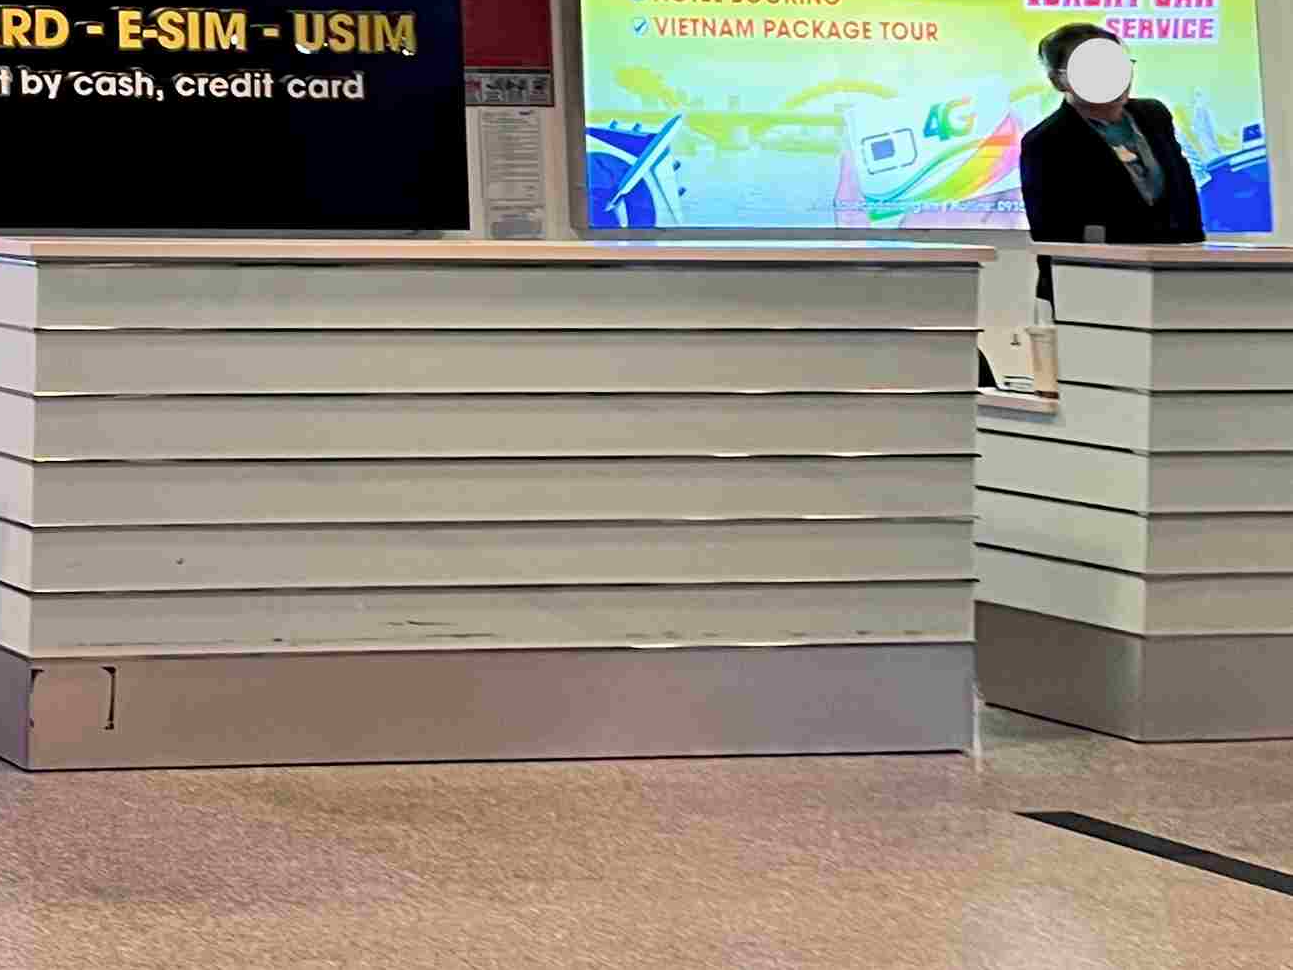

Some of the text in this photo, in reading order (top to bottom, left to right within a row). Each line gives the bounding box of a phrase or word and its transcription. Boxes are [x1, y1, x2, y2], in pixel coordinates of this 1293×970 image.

[117, 7, 248, 51] E-SIM
[293, 11, 418, 55] USIM
[656, 16, 939, 41] VIETNAM PACKAGE TOUR
[1106, 17, 1215, 40] SERVICE
[21, 68, 62, 100] by
[72, 69, 165, 101] cash,
[175, 72, 274, 99] credit
[286, 73, 365, 100] card
[923, 94, 978, 140] 4G
